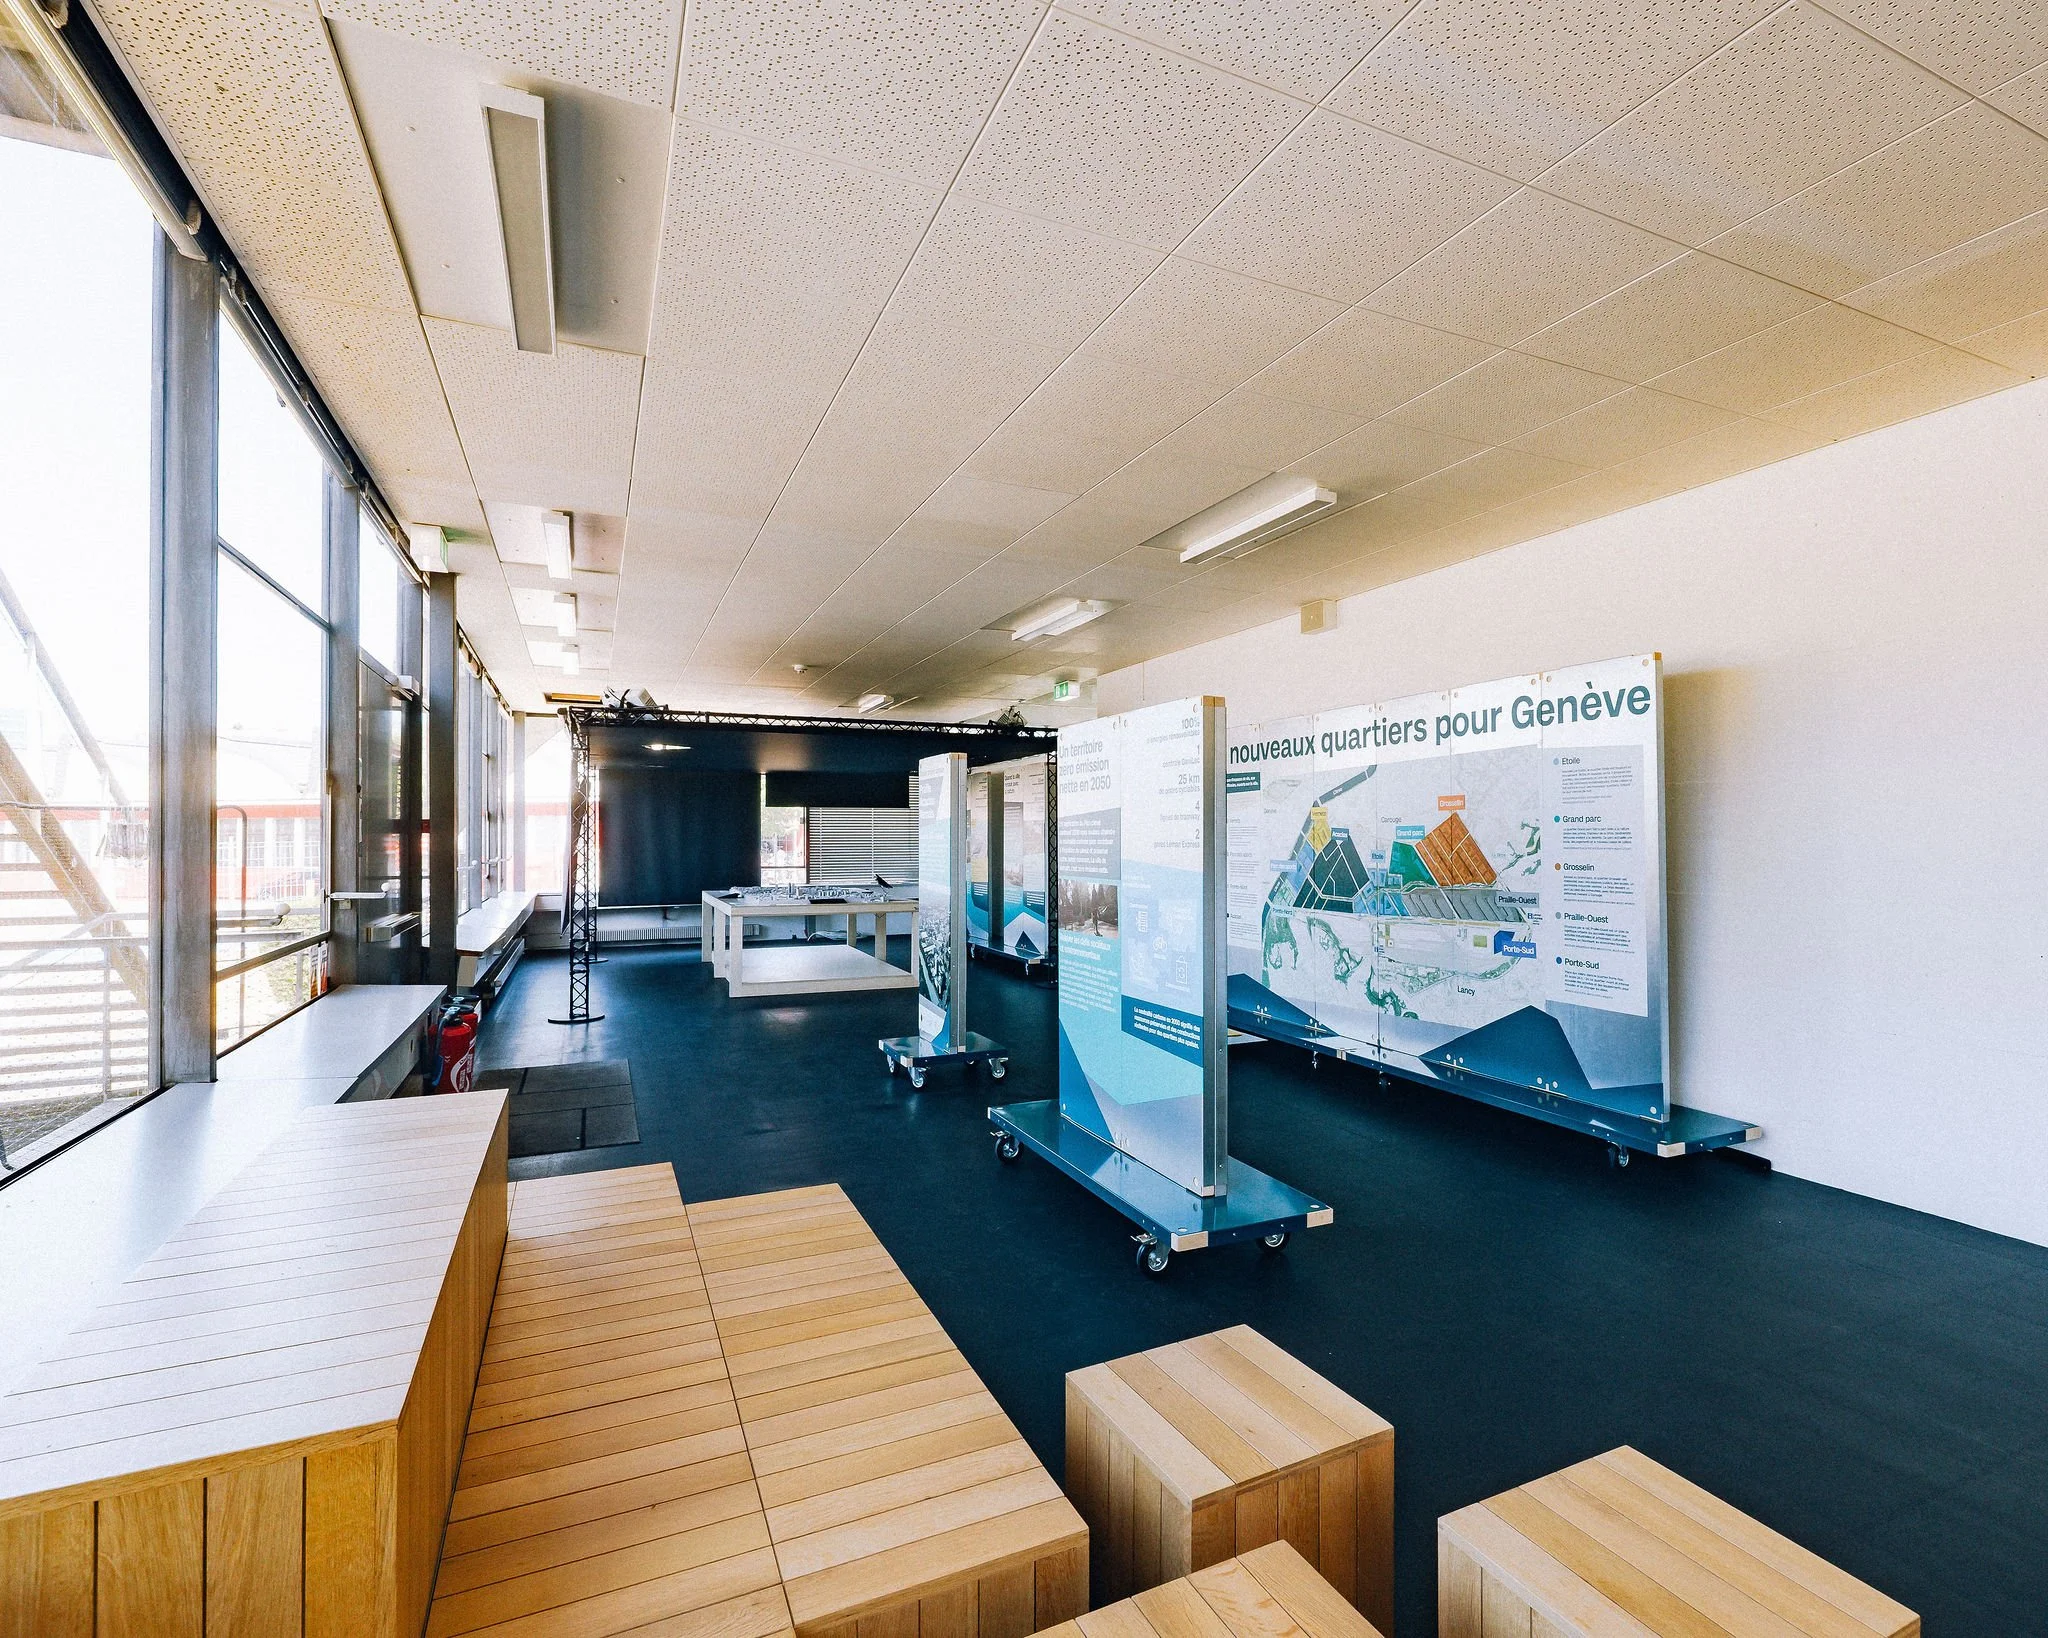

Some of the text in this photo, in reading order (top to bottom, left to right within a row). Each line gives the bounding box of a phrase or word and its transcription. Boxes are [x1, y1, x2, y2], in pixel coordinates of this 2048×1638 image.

[1230, 681, 1652, 765] nouveaux quartiers pour Genève
[1059, 741, 1103, 759] Un territoire
[1076, 759, 1109, 775] émission
[1561, 757, 1581, 765] Etoile
[1059, 779, 1079, 794] nette
[1080, 780, 1089, 791] en
[1090, 775, 1111, 791] 2050
[1178, 773, 1200, 785] 25 km
[1195, 800, 1200, 811] 4
[1562, 815, 1602, 824] Grand parc
[1195, 828, 1200, 840] 2
[1563, 862, 1595, 872] Grosselin
[1498, 895, 1538, 905] Praille-Ouest
[1564, 912, 1609, 924] Praille-Ouest
[1503, 945, 1535, 955] Porte-Sud
[1564, 957, 1600, 970] Porte-Sud
[1457, 985, 1476, 997] Lancy
